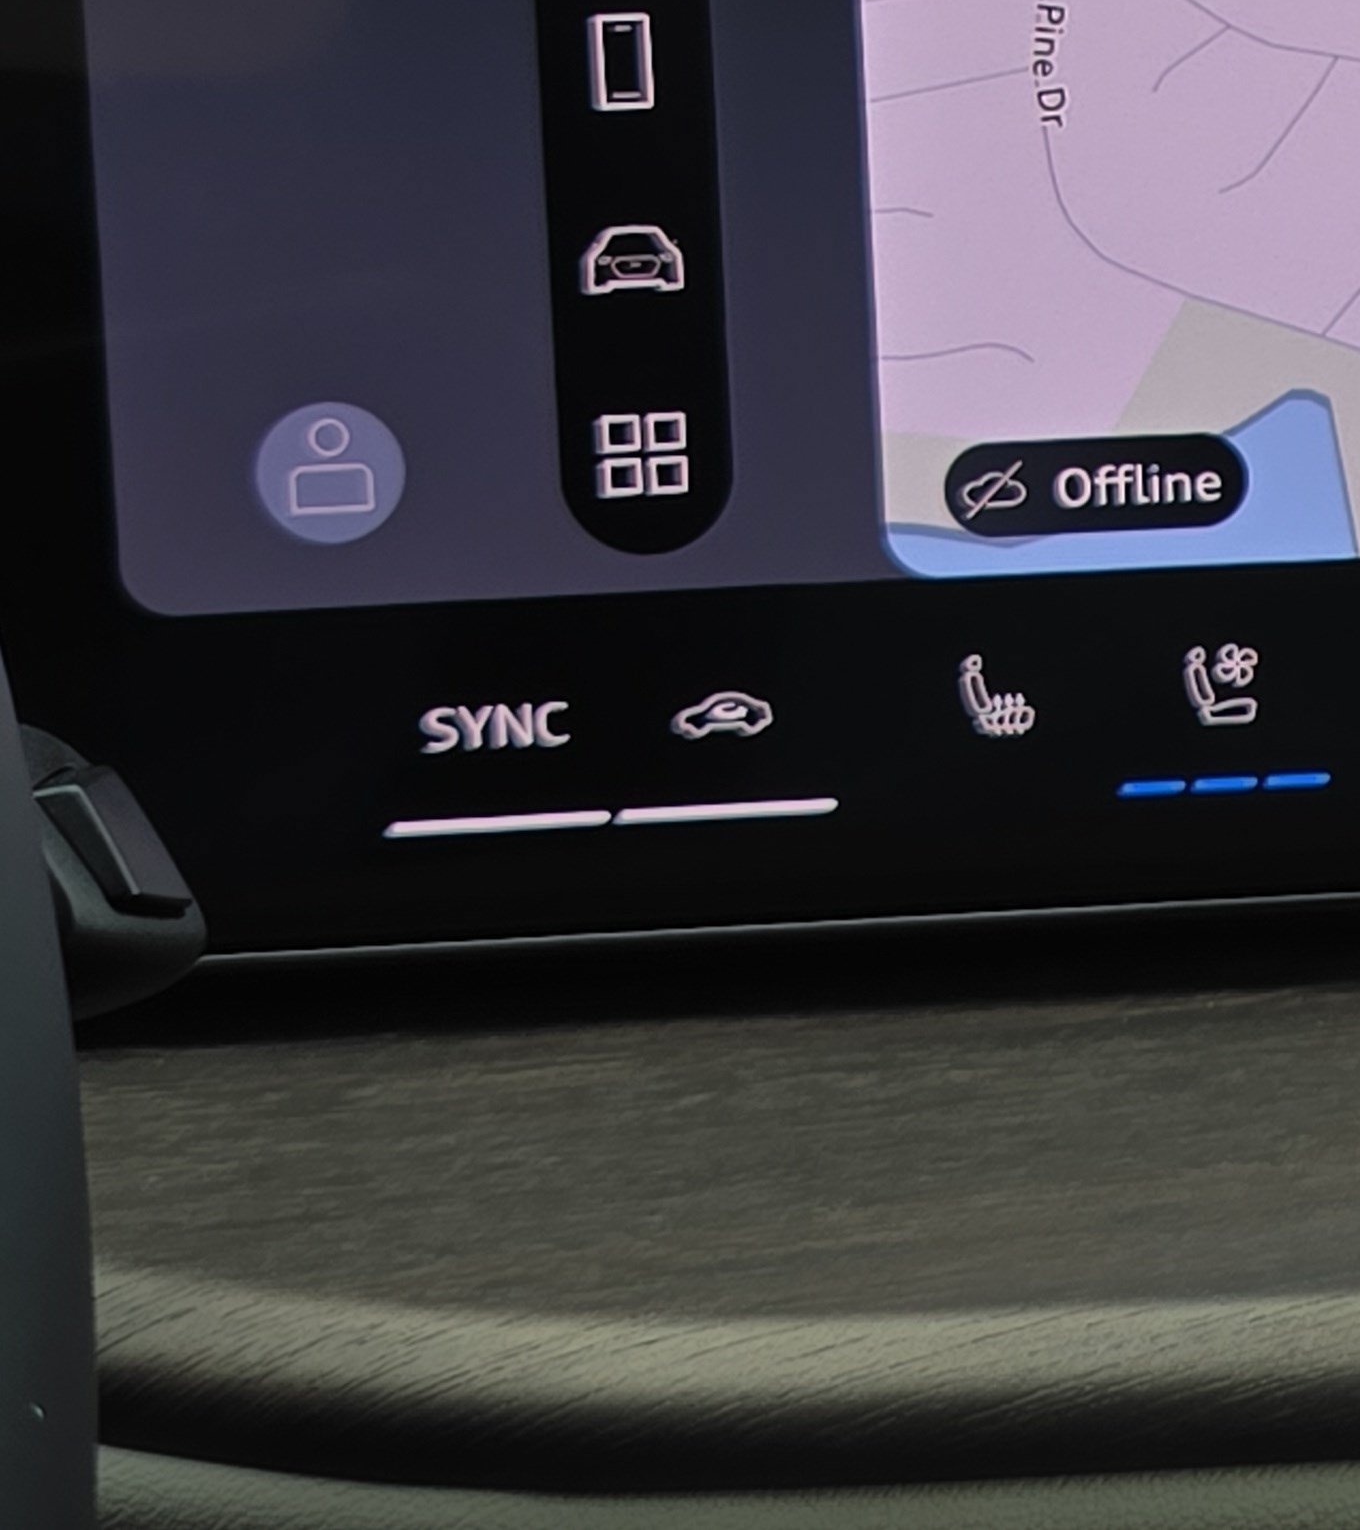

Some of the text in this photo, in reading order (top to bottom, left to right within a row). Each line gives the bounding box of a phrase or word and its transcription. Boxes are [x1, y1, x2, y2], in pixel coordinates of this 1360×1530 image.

[1032, 3, 1067, 78] Pine
[1035, 86, 1067, 128] Dr
[1055, 464, 1222, 508] Offline
[419, 700, 572, 755] SYNC
